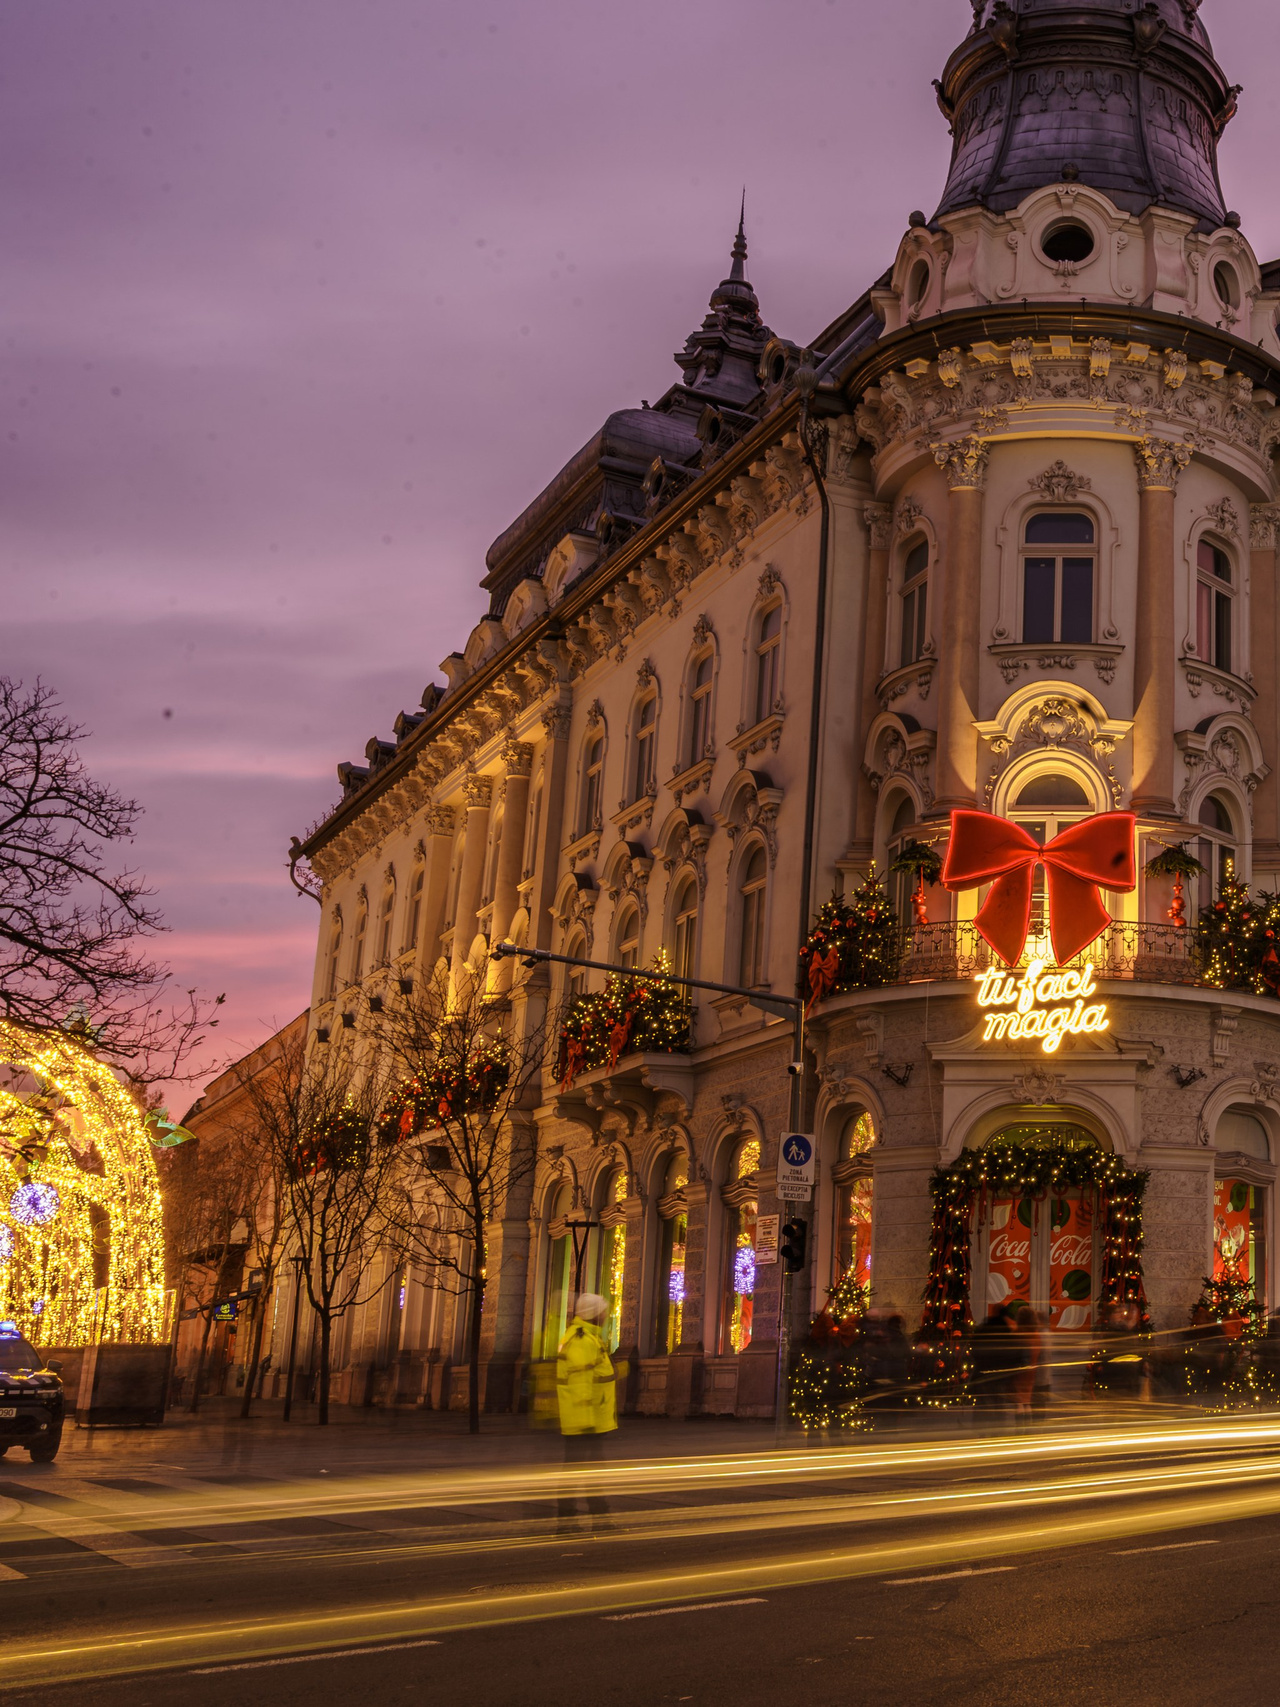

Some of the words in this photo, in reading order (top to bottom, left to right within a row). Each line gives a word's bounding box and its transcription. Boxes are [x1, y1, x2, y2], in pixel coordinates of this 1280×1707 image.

[974, 965, 1019, 1007] tu
[1016, 959, 1097, 1014] faci
[983, 999, 1110, 1054] magia
[988, 1233, 1030, 1264] Coca
